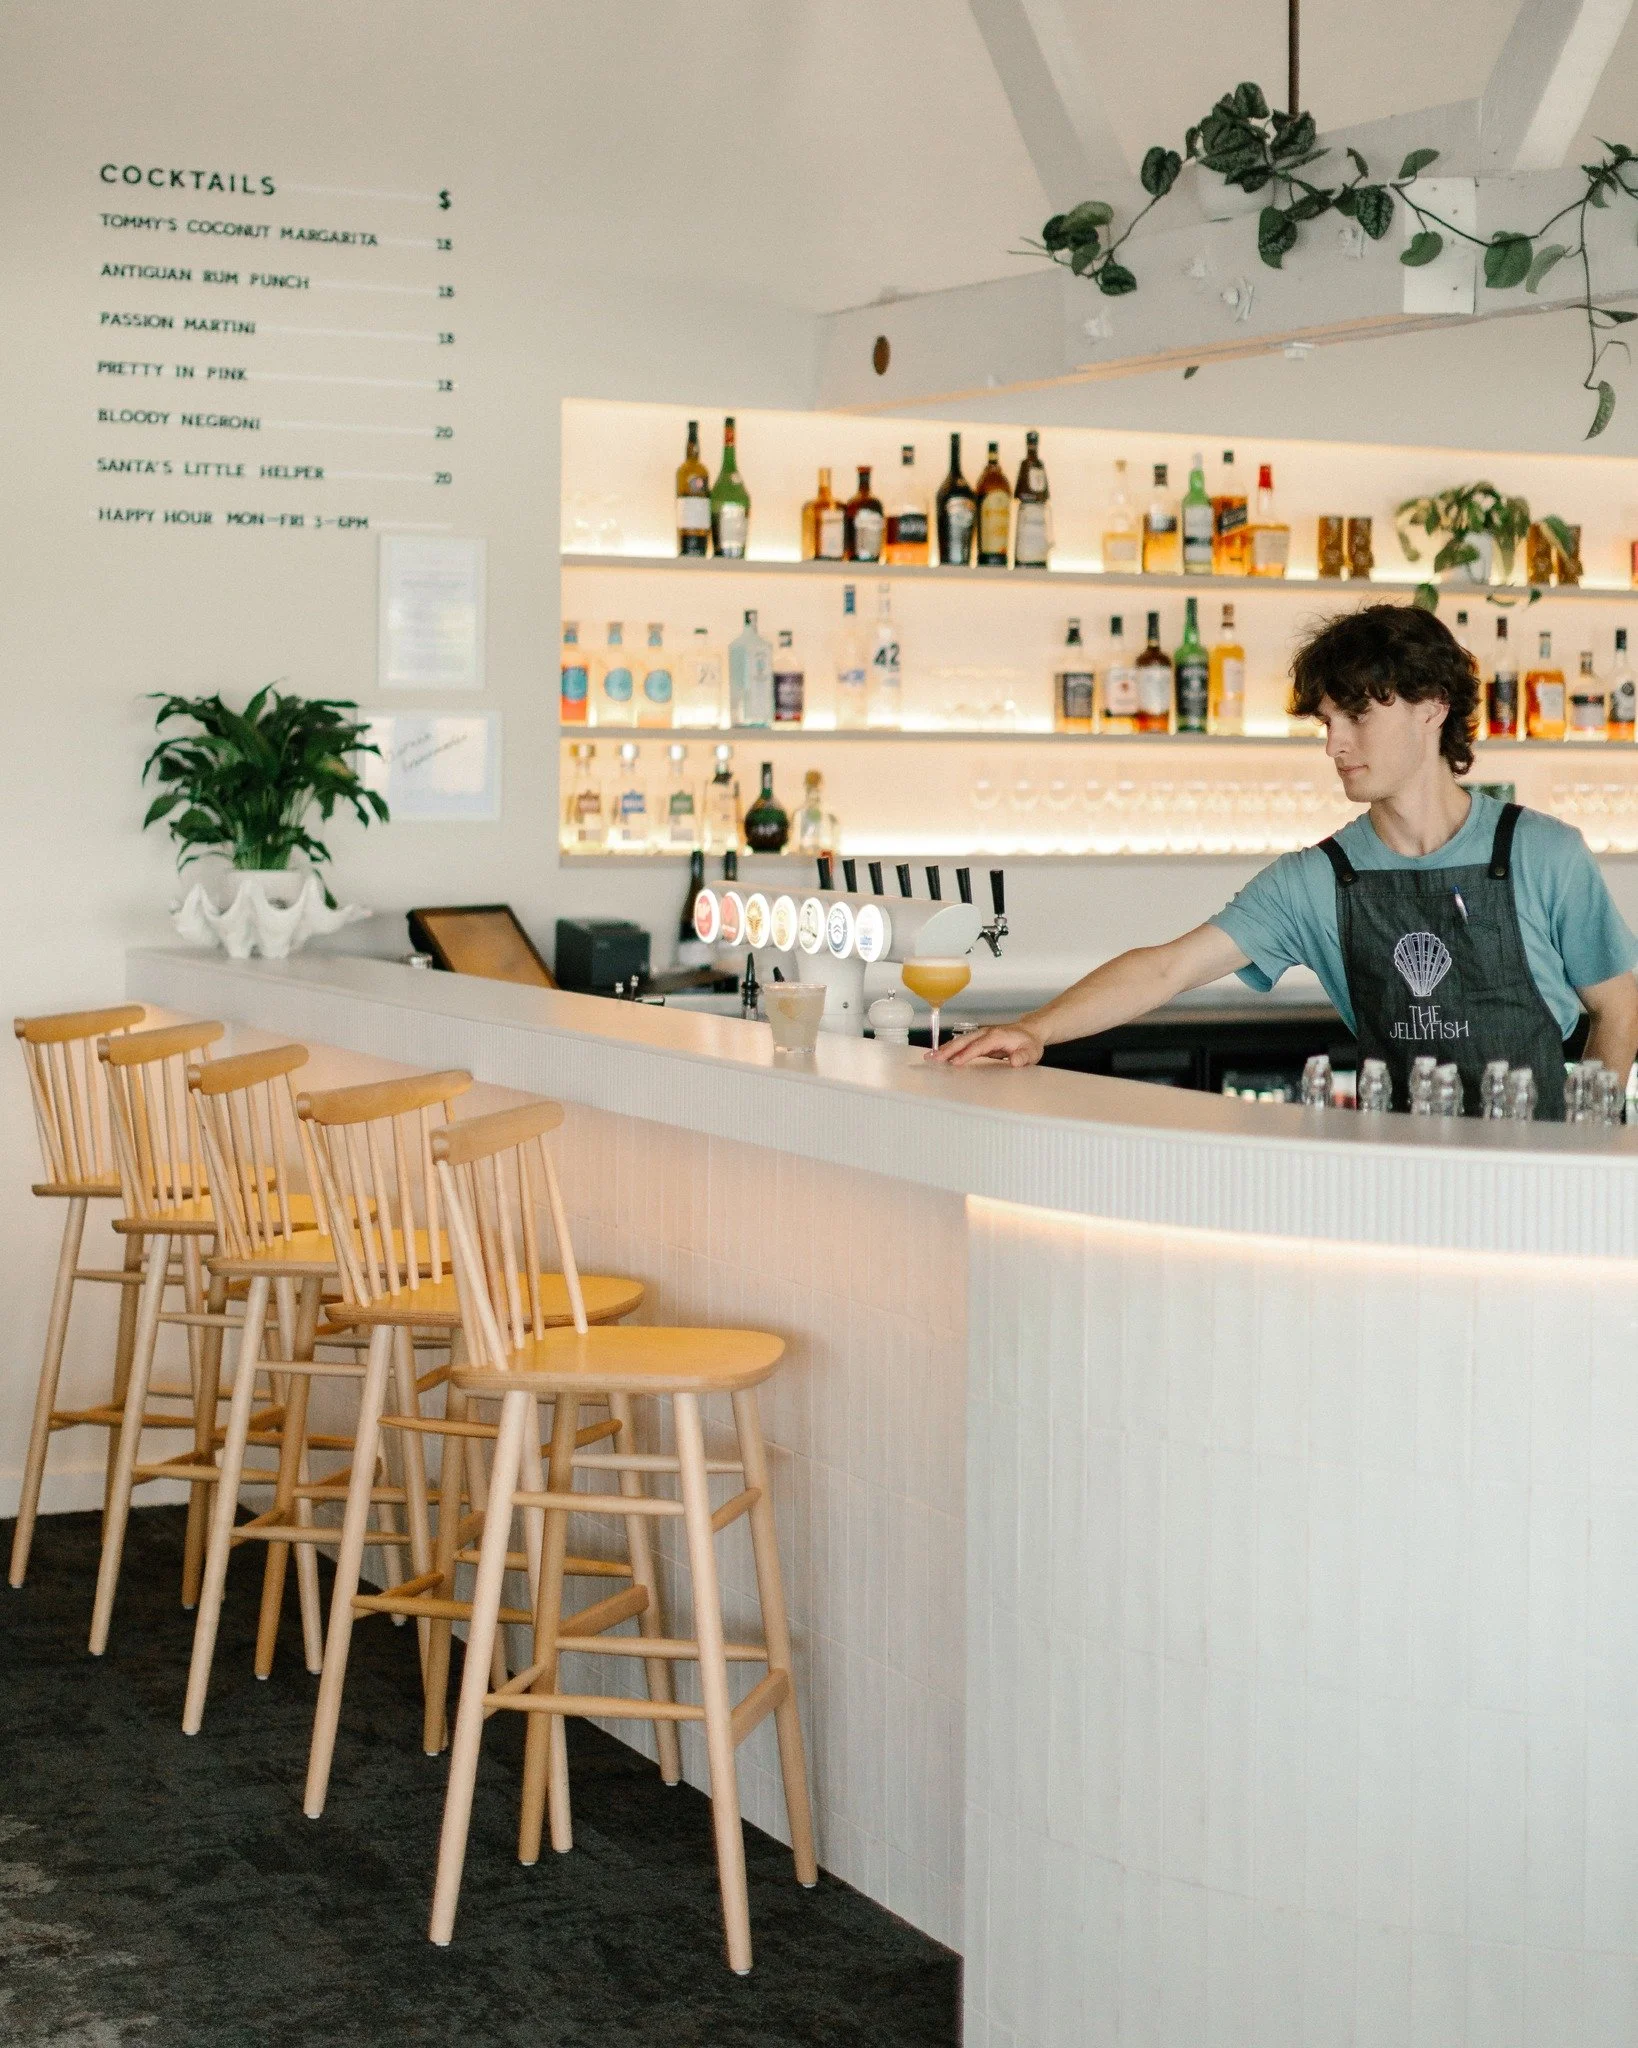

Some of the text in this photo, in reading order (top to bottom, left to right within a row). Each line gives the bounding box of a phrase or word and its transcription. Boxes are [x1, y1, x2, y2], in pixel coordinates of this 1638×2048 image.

[99, 163, 452, 212] COCKTAILS $
[100, 213, 453, 251] TOMMY'S COCONUT MARGARITA 18
[100, 263, 455, 299] ANTIGUAN RUM PUNCH 18
[100, 312, 455, 344] PASSION MARTINI 18
[97, 361, 453, 392] PRETTY IN PINK 18
[98, 408, 453, 439] BLOODY NEGRONI 20
[97, 457, 452, 485] SANTA'S LITTLE HELPER 20
[99, 507, 155, 522] HAPPY
[164, 510, 212, 525] HOUR
[874, 641, 900, 666] 42
[1389, 1020, 1470, 1040] JELLYFISH
[1409, 1006, 1441, 1023] THE
